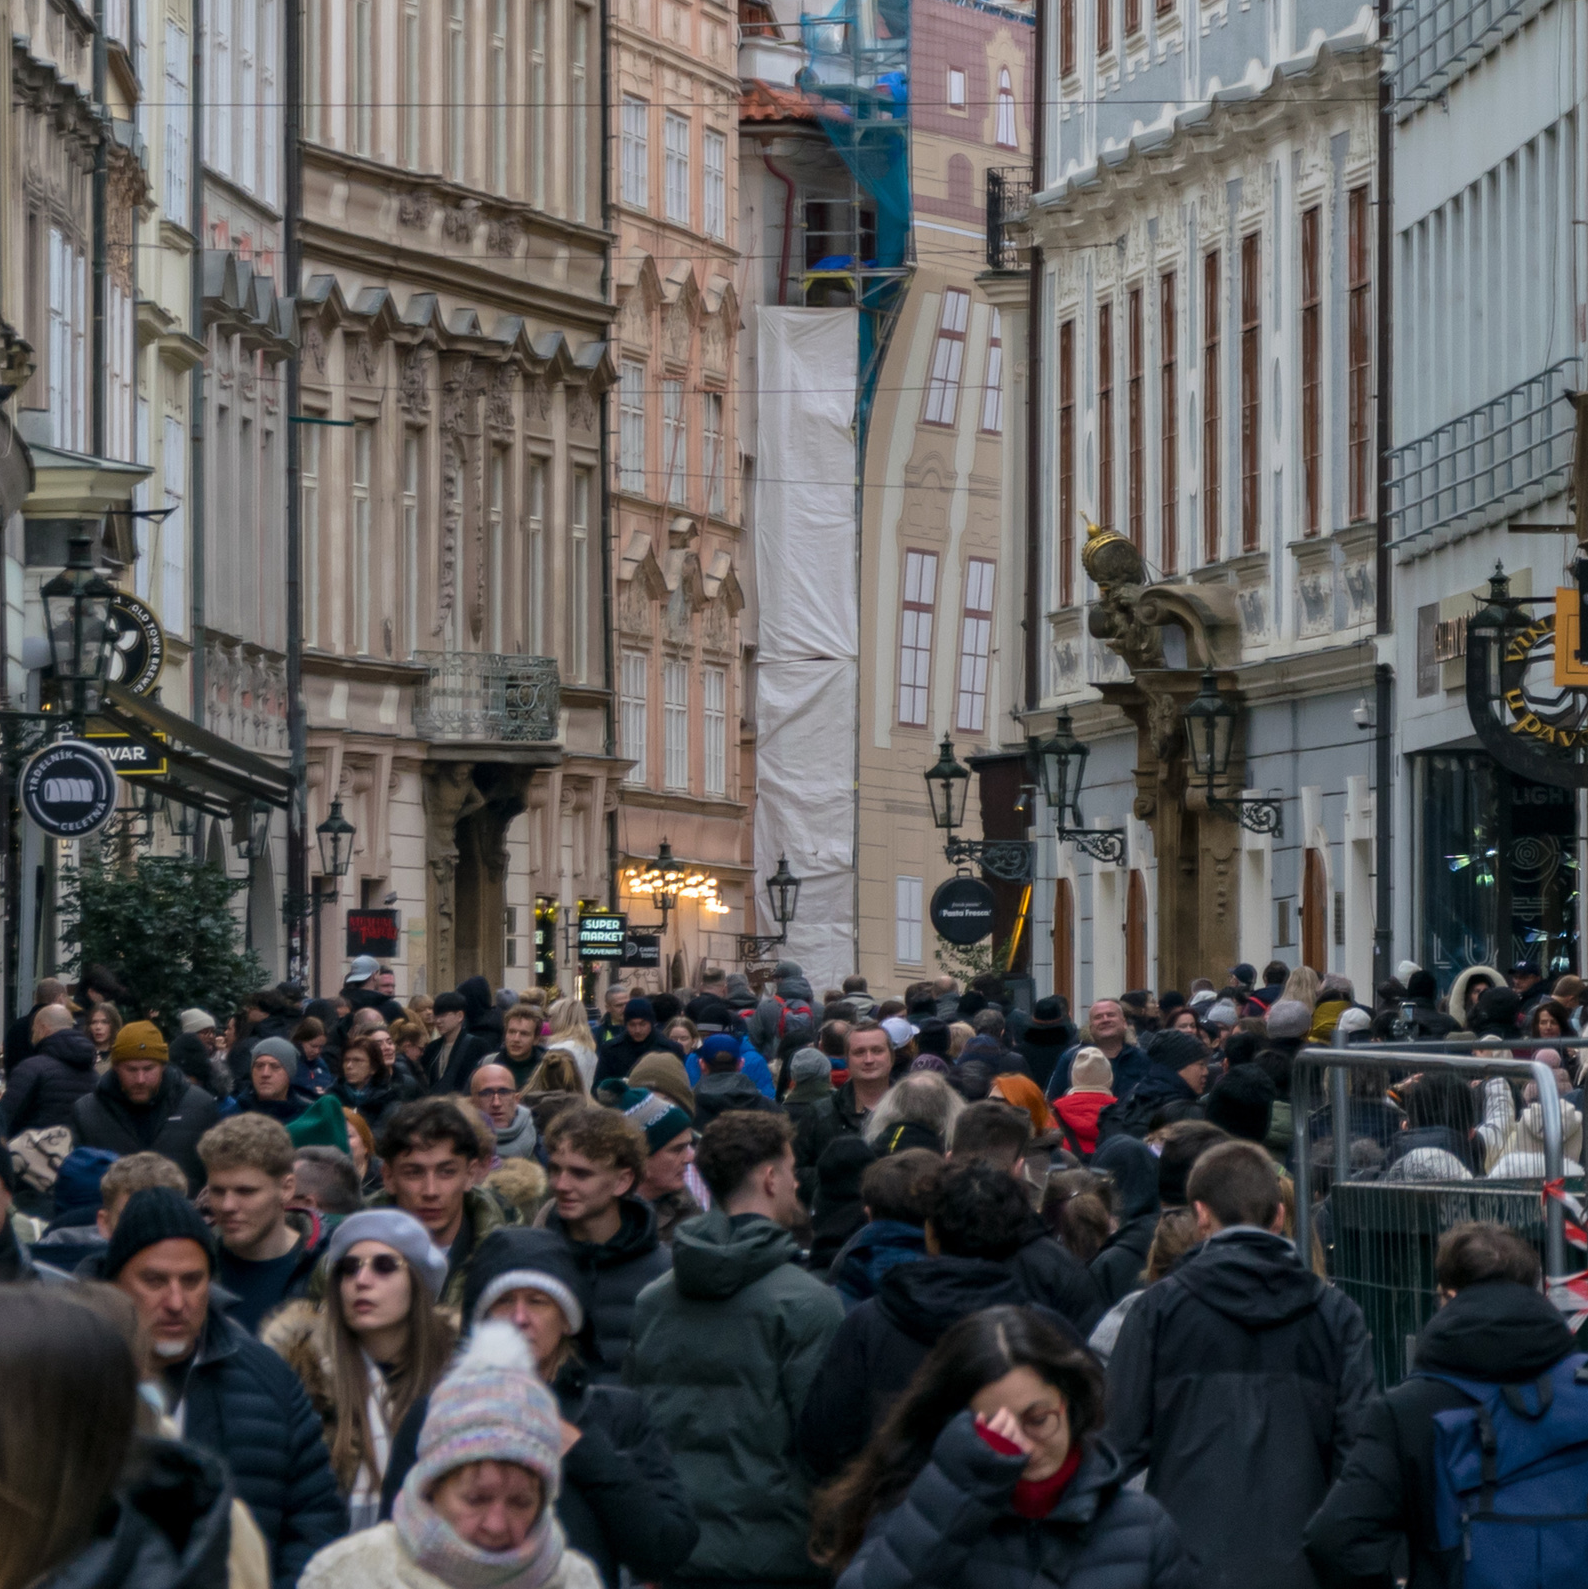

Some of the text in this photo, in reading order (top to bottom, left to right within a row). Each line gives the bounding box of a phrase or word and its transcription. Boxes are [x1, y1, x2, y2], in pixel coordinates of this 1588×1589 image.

[132, 603, 161, 693] OLD TOWN BREWE
[29, 748, 75, 792] TRDELNÍK
[60, 800, 107, 832] CELETNÁ
[580, 930, 625, 942] MARKET
[585, 919, 621, 930] SUPER
